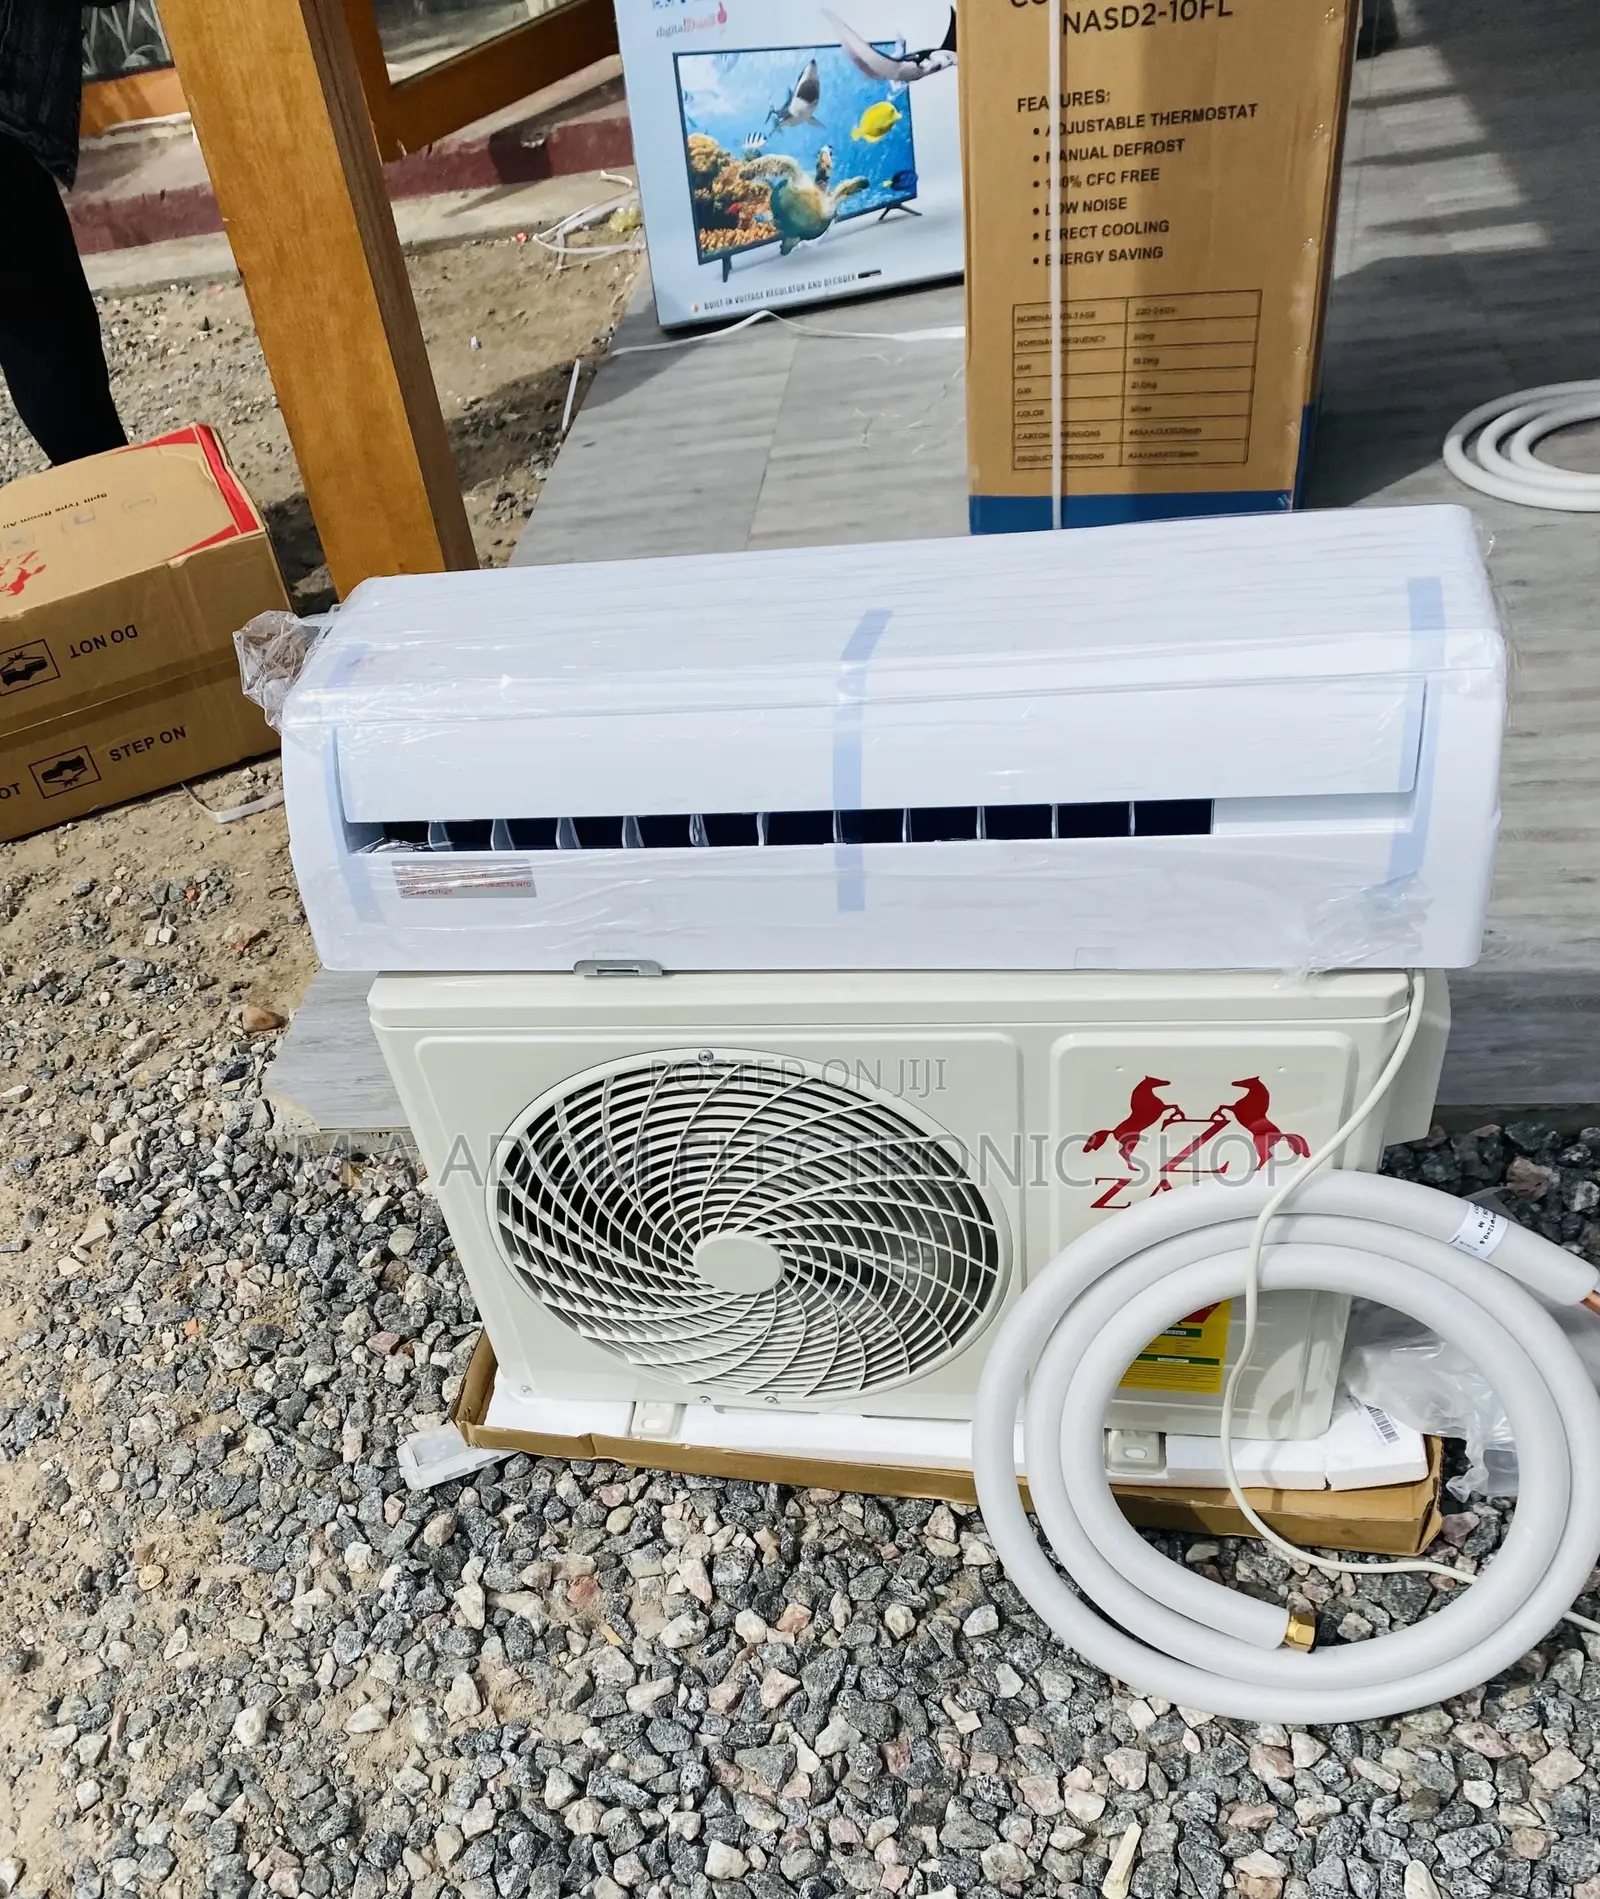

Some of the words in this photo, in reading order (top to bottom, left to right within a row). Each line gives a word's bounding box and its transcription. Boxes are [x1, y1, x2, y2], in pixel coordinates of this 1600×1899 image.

[1063, 0, 1233, 35] NASD2-10FL
[1017, 89, 1111, 113] FEAURES:
[1150, 103, 1258, 127] THERMOSTAT
[1113, 138, 1186, 158] DEFROST
[1045, 174, 1082, 189] 10%
[1086, 171, 1116, 187] CFC
[1120, 167, 1161, 184] FREE
[1082, 196, 1128, 213] NOISE
[1045, 225, 1098, 241] DRECT
[1101, 219, 1170, 237] COOLING
[1108, 246, 1164, 262] SAVING
[765, 284, 806, 298] REGULATOR
[807, 280, 823, 291] AND
[824, 272, 857, 287] DECODER
[1016, 313, 1053, 324] NOMINA
[1016, 337, 1053, 348] NOMINA
[111, 624, 139, 644] DO
[69, 634, 107, 659] NOT
[109, 736, 155, 762] STEP
[159, 726, 187, 744] ON
